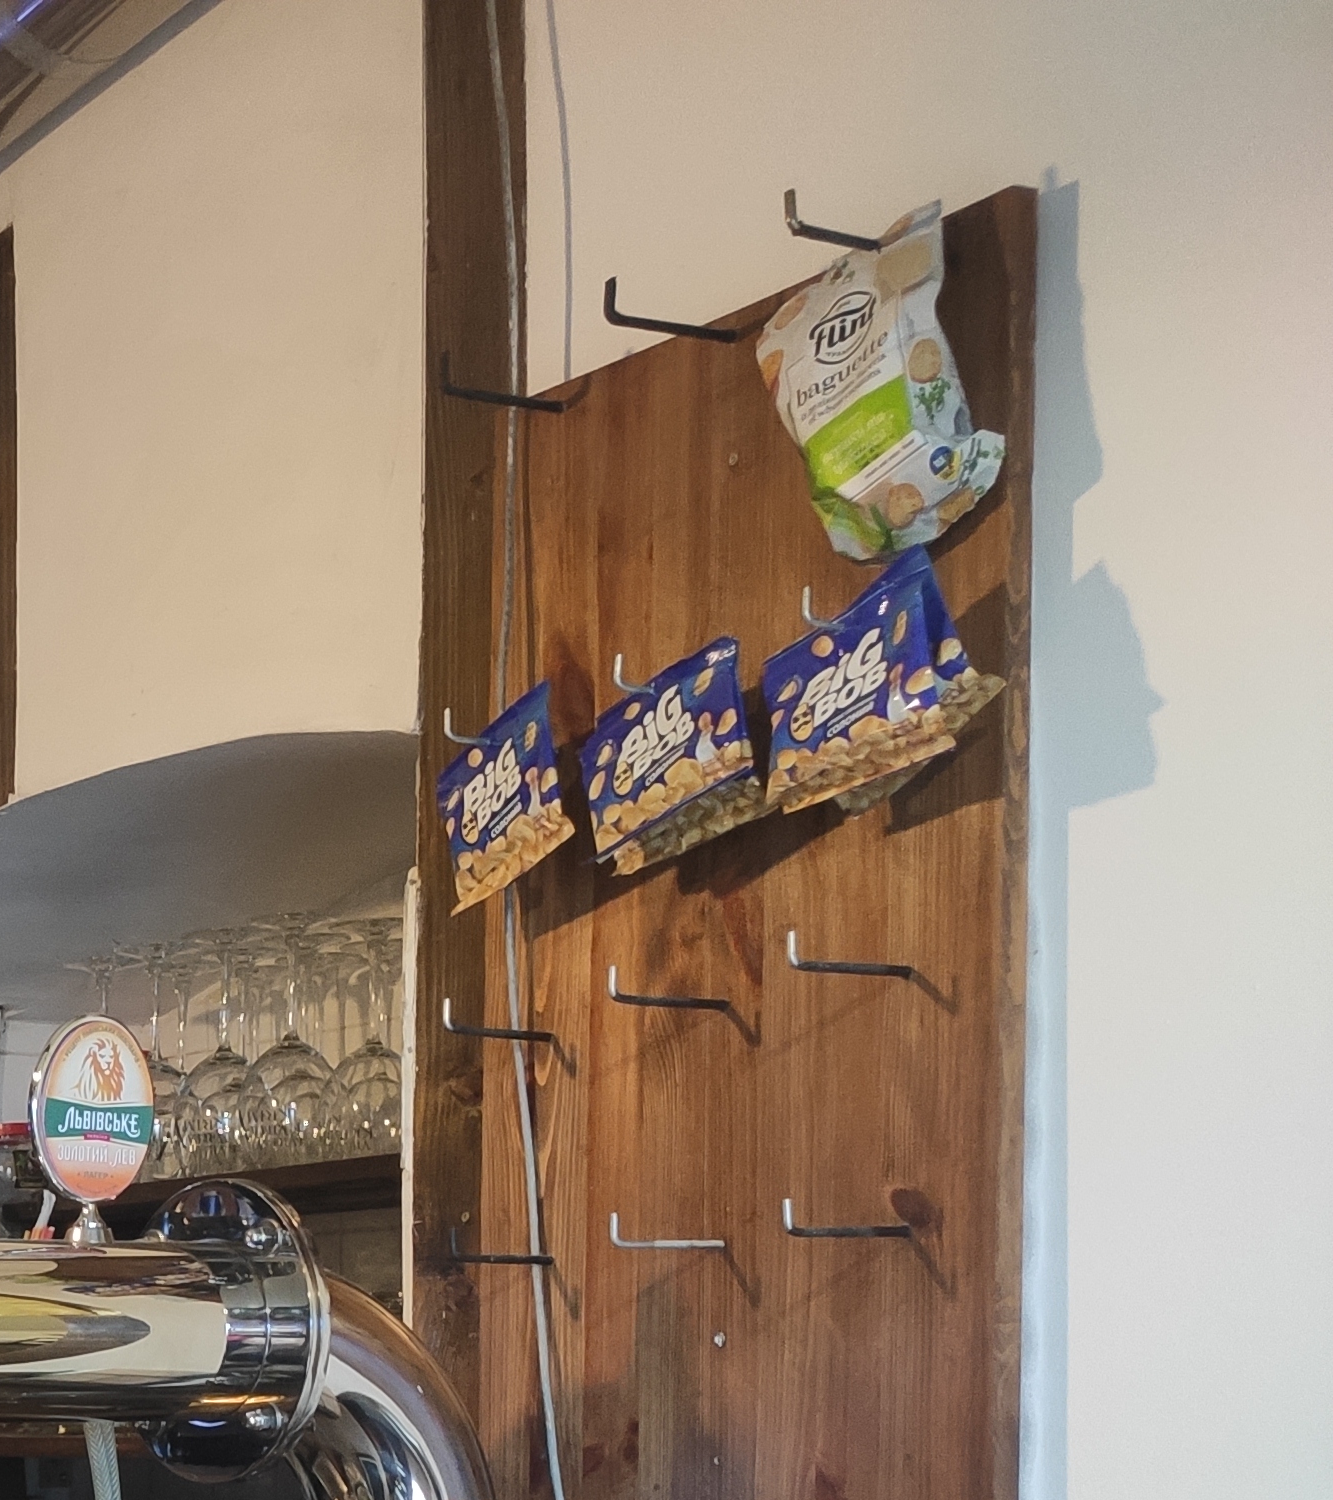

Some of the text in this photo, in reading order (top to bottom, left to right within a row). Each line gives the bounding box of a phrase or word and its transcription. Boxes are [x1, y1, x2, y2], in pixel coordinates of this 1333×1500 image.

[796, 331, 889, 407] baguette
[814, 660, 887, 728] BOB
[632, 711, 695, 781] BOB
[476, 765, 522, 831] BOB
[57, 1143, 136, 1168] ЗОЛОТИЙ ЛЕВ
[58, 1106, 140, 1138] ЛЬВІВСЬКЕ
